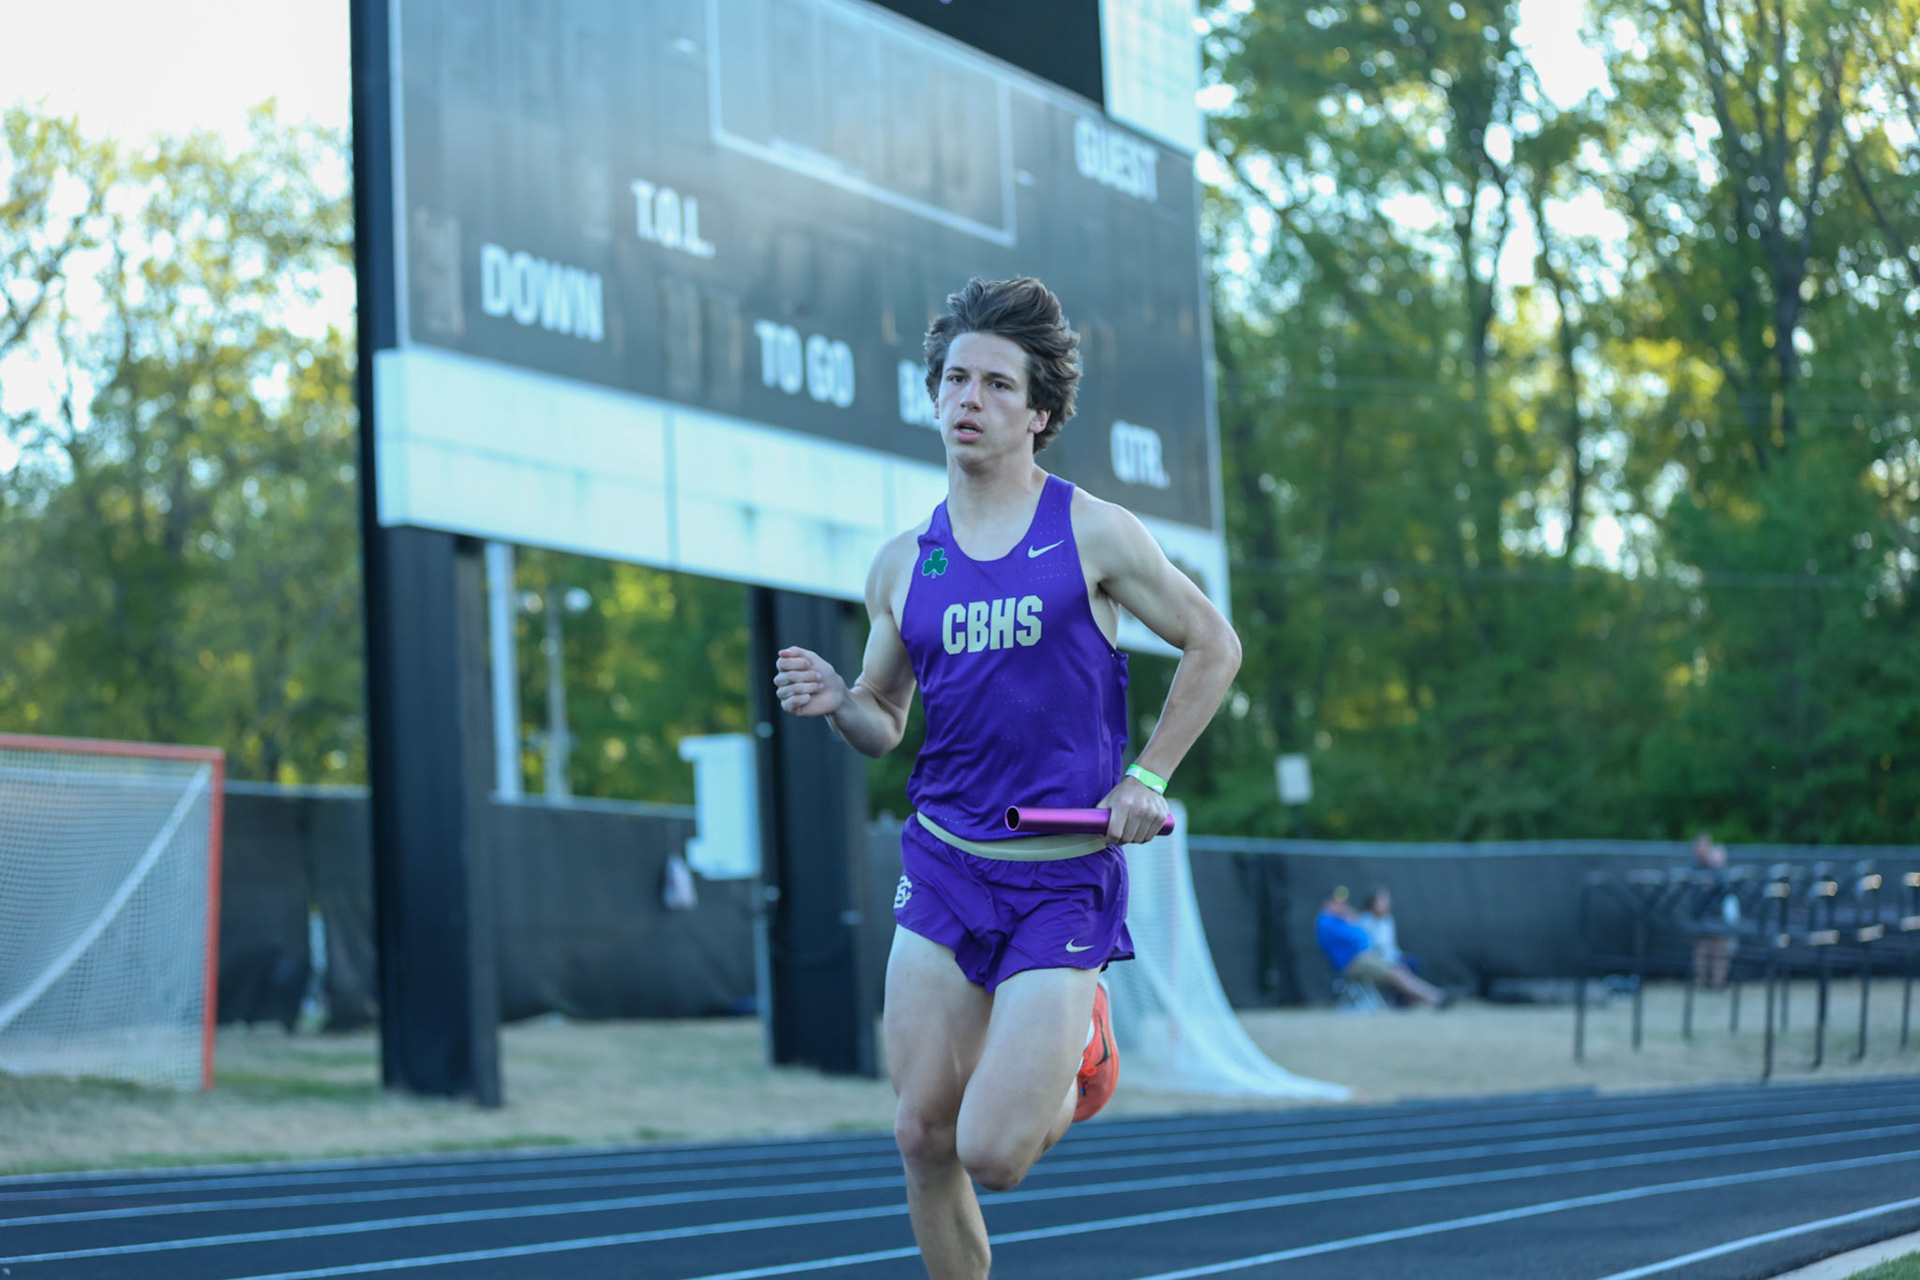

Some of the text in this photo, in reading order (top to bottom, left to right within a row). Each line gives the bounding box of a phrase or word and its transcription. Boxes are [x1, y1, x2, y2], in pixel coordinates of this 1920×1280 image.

[1075, 118, 1159, 202] GUEST
[481, 242, 604, 342] DOWN
[755, 319, 855, 407] TO GO
[942, 595, 1043, 655] CBHS
